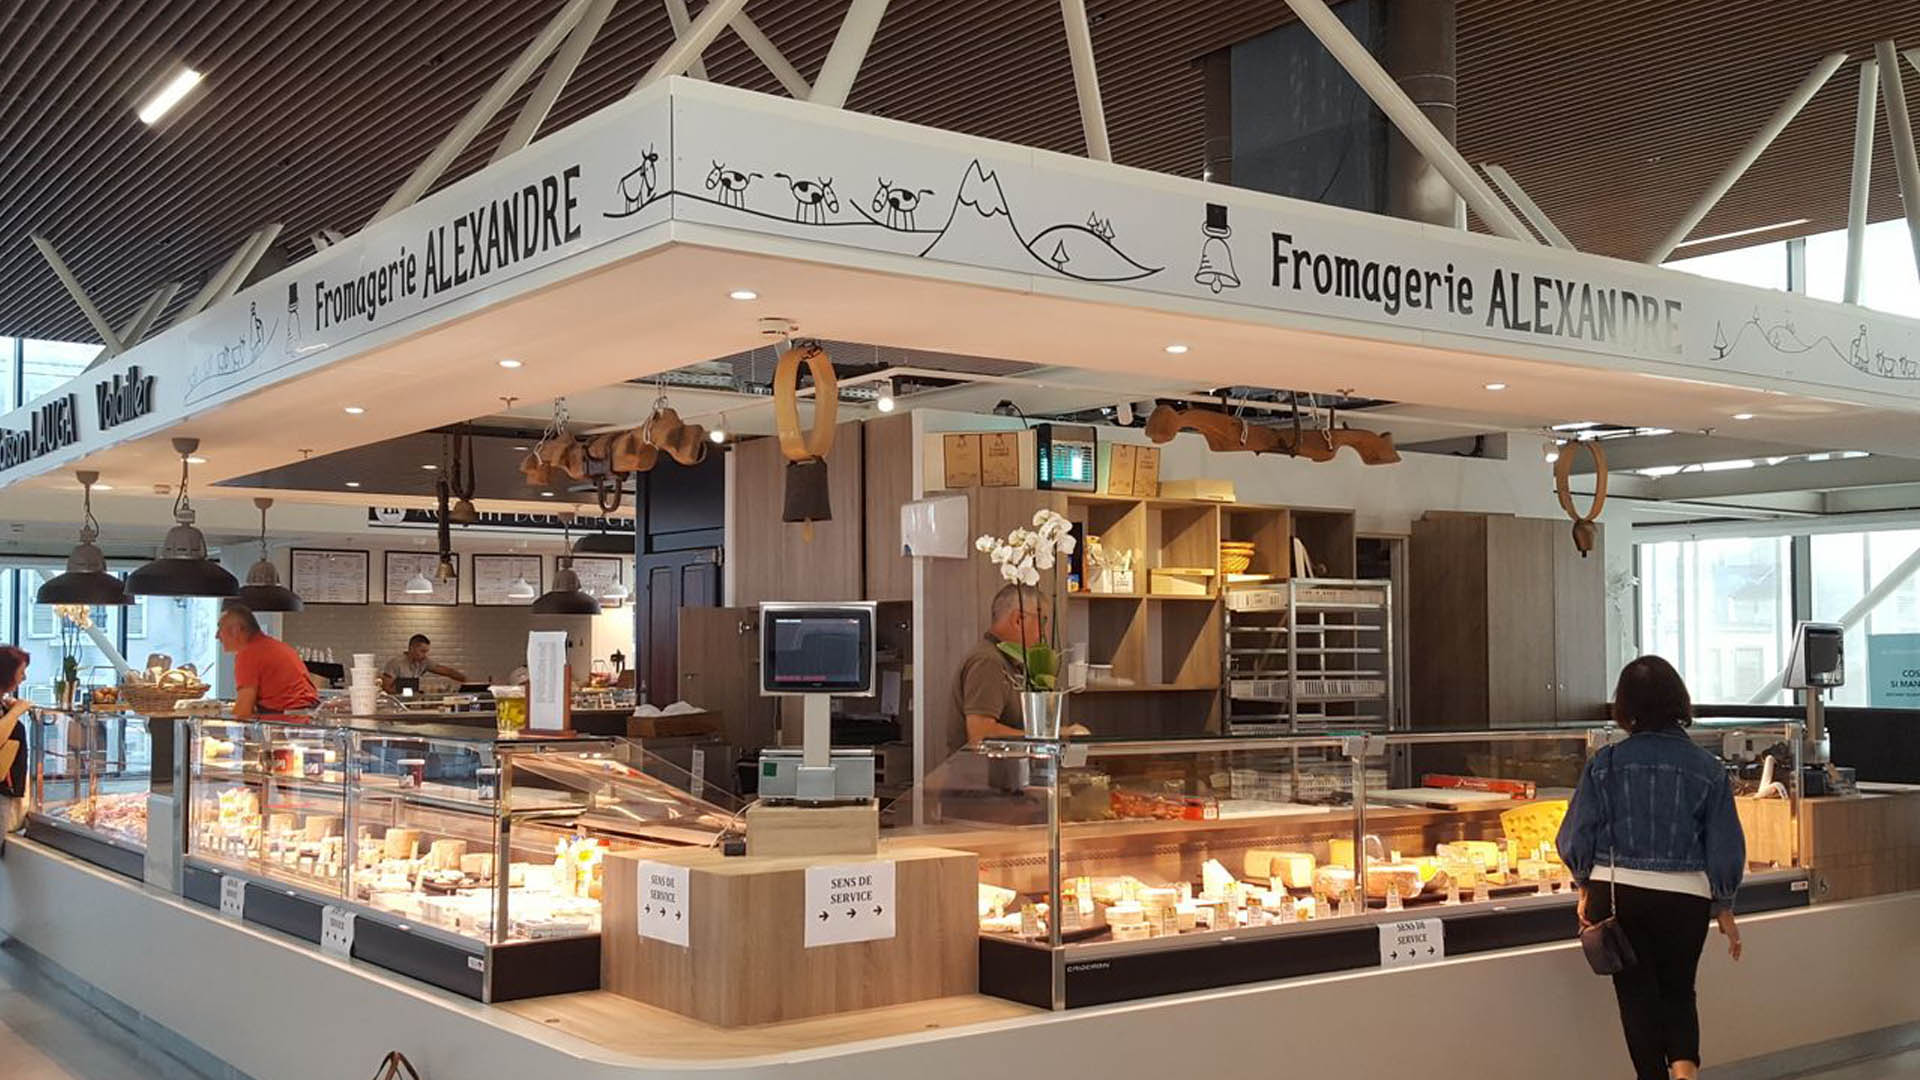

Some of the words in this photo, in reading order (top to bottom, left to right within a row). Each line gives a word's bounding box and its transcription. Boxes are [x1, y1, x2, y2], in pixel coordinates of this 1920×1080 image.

[315, 246, 416, 331] Fromagerie
[422, 164, 581, 299] ALEXANDRE
[1272, 232, 1473, 316] Fromagerie
[1486, 268, 1682, 354] ALEXANDRE
[31, 393, 81, 458] LAUGA
[651, 874, 665, 887] SENS
[665, 876, 675, 889] DE
[831, 877, 857, 889] SENS
[859, 875, 873, 886] DE
[651, 889, 676, 903] SERVICE
[830, 890, 873, 904] SERVICE
[1397, 934, 1427, 944] SERVICE
